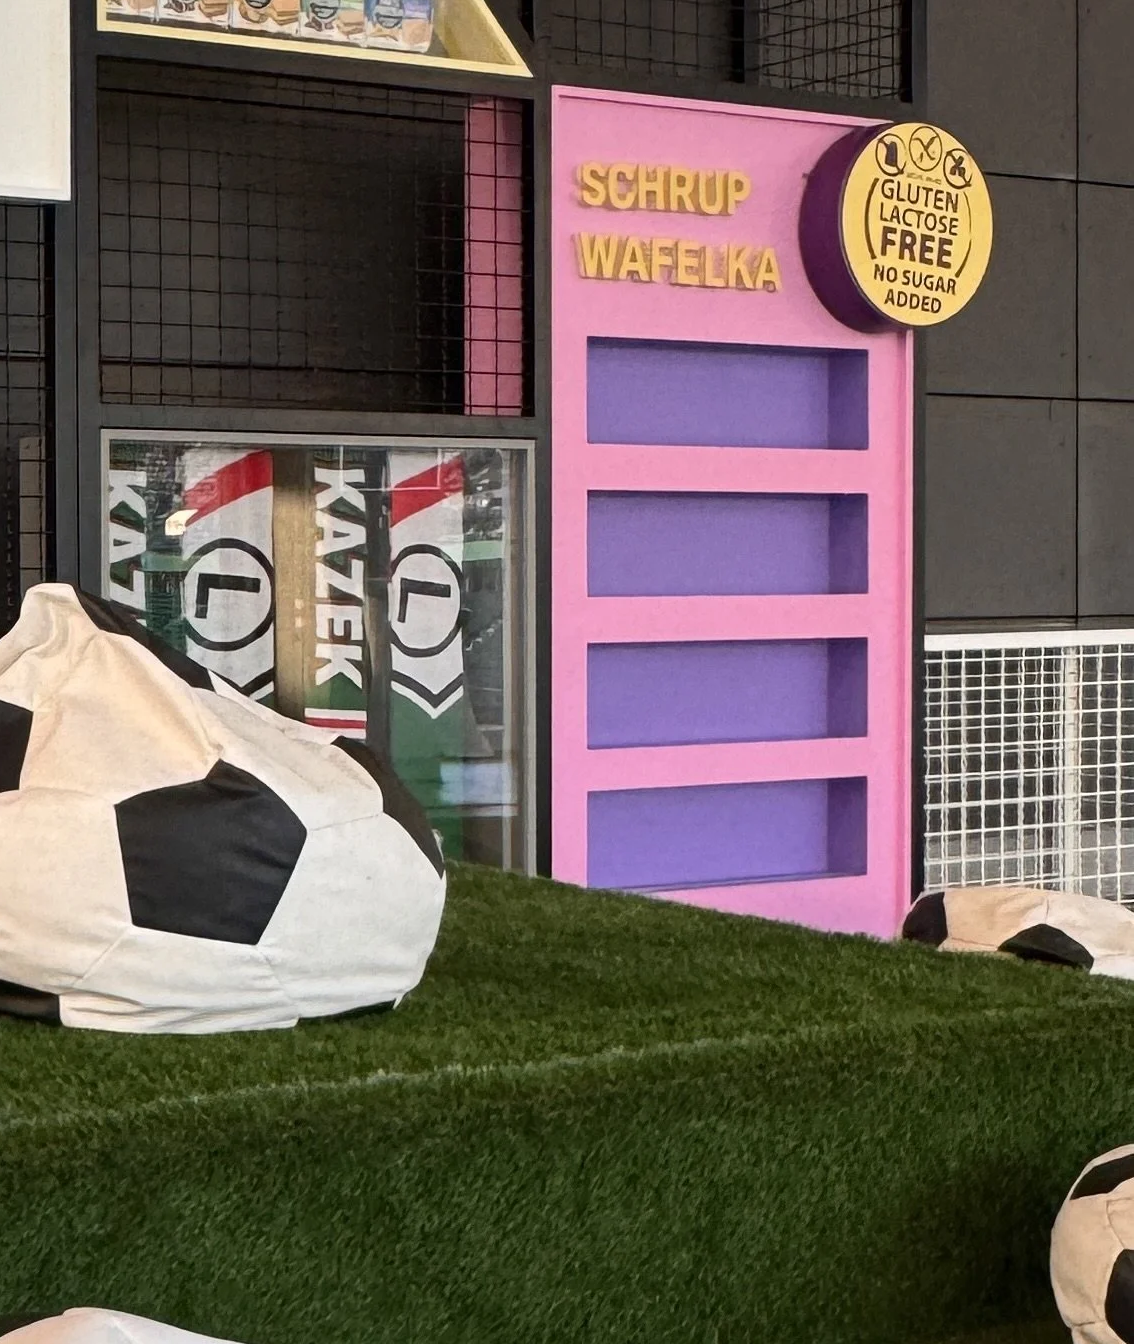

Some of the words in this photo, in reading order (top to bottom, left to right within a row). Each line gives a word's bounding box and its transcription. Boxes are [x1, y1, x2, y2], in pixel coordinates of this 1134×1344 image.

[575, 162, 751, 216] SCHRUP
[881, 179, 959, 213] GLUTEN
[880, 202, 959, 236] LACTOSE
[573, 231, 783, 294] WAFELKA
[880, 226, 954, 269] FREE
[874, 264, 898, 283] NO
[902, 270, 957, 295] SUGAR
[884, 288, 942, 314] ADDED
[315, 466, 367, 690] KAZEK
